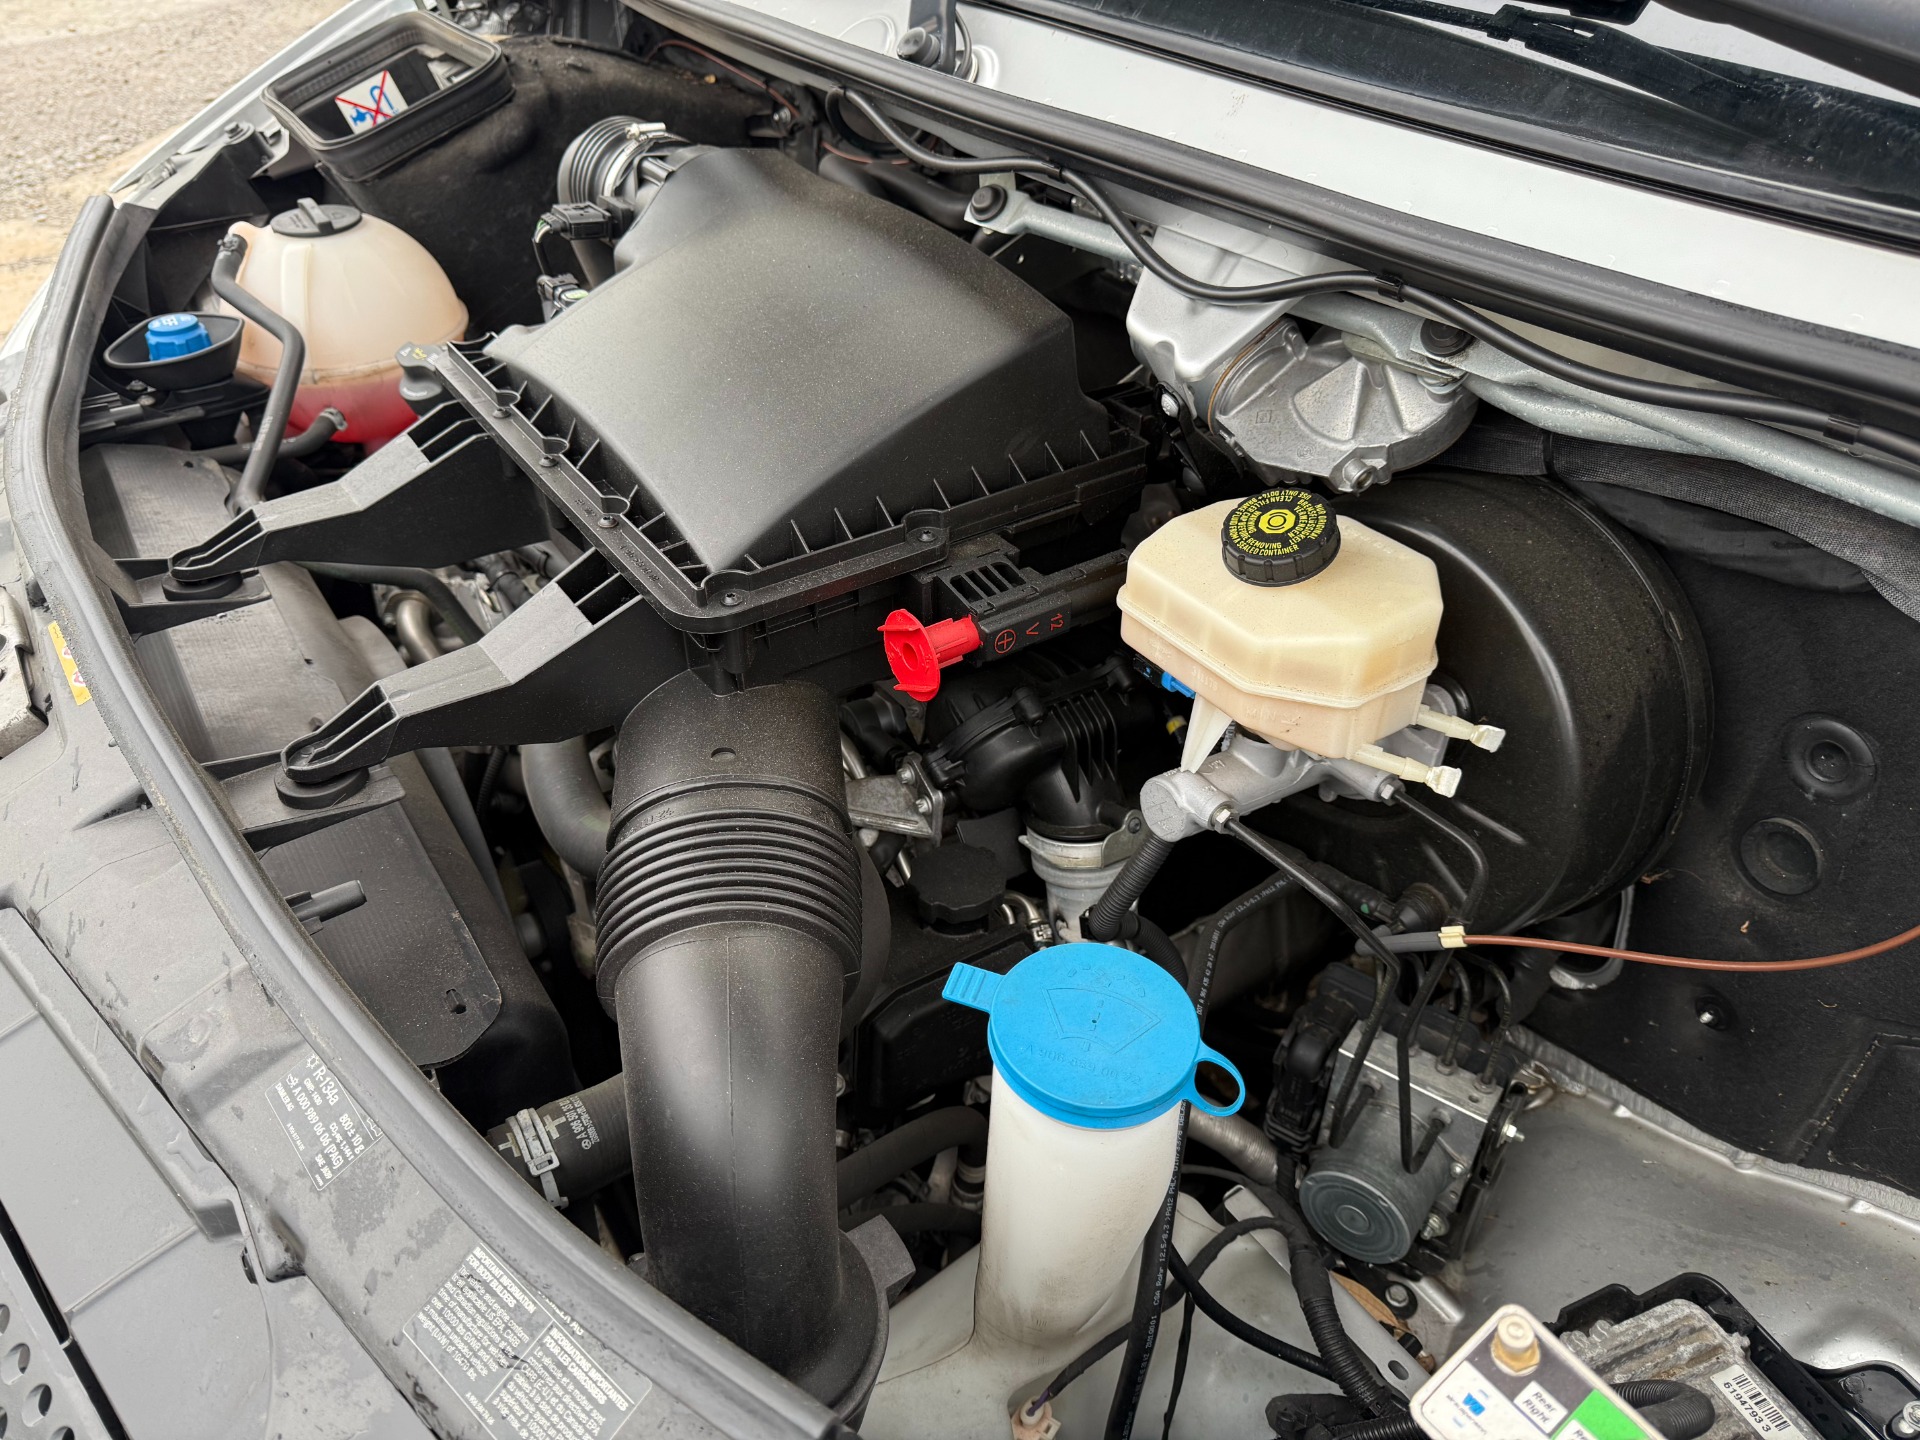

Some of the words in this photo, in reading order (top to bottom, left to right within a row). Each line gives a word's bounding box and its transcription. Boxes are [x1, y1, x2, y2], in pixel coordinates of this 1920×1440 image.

[1237, 497, 1257, 512] BRAKE
[1248, 497, 1269, 511] FILLER
[1297, 492, 1310, 500] USE
[1229, 510, 1239, 525] FLUID
[1240, 511, 1250, 520] CAP
[1247, 510, 1262, 533] WARNING
[1236, 540, 1259, 554] SEALED
[1247, 537, 1281, 548] REMOVING
[1258, 544, 1298, 555] CONTAINER
[1025, 622, 1040, 638] V
[1049, 612, 1064, 630] 12
[292, 1086, 302, 1096] A
[313, 1066, 339, 1105] R-134a
[296, 1092, 310, 1110] 000
[311, 1091, 322, 1105] 1430
[275, 1082, 290, 1104] DAIMLER
[285, 1102, 294, 1112] AG
[315, 1153, 326, 1167] SAE
[304, 1107, 319, 1124] 989
[339, 1113, 353, 1130] 800
[565, 1110, 578, 1121] 501
[570, 1119, 584, 1133] 906
[313, 1122, 325, 1136] 06
[319, 1132, 331, 1146] 06
[576, 1131, 587, 1139] A
[351, 1134, 363, 1146] 10
[354, 1144, 365, 1154] g
[324, 1143, 344, 1169] (PAG)
[1168, 1174, 1176, 1194] PHL<
[1164, 1197, 1173, 1221] >PA12
[466, 1254, 480, 1269] FOR
[476, 1265, 494, 1282] BODY
[490, 1279, 516, 1307] BUILDERS
[473, 1247, 503, 1278] IMPORTANT
[500, 1275, 536, 1313] INFORMATION
[1155, 1266, 1164, 1286] Rohr
[444, 1281, 457, 1294] and
[453, 1290, 476, 1316] Canadian
[474, 1313, 501, 1343] regulations
[504, 1345, 516, 1358] the
[451, 1272, 459, 1282] to
[456, 1279, 466, 1288] all
[462, 1286, 487, 1312] applicable
[485, 1308, 496, 1321] US
[491, 1316, 505, 1333] EPA,
[502, 1329, 520, 1347] CARB
[467, 1277, 485, 1296] vehicle
[483, 1293, 495, 1305] and
[490, 1303, 510, 1322] engine
[508, 1320, 530, 1343] conform
[431, 1296, 444, 1310] over
[442, 1307, 459, 1326] 10000
[456, 1323, 466, 1335] lbs
[463, 1332, 481, 1351] GVWR
[477, 1349, 490, 1362] and
[486, 1358, 499, 1372] has
[437, 1288, 450, 1303] time
[448, 1300, 457, 1308] of
[453, 1306, 483, 1339] manufacture
[481, 1335, 491, 1347] for
[488, 1344, 509, 1368] vehicles
[417, 1312, 435, 1332] weight
[431, 1328, 449, 1349] (UVW)
[446, 1345, 456, 1353] of
[452, 1350, 470, 1371] 10470
[428, 1308, 452, 1335] maximum
[449, 1332, 473, 1358] unloaded
[470, 1355, 488, 1377] vehicle
[543, 1335, 561, 1355] POUR
[557, 1351, 571, 1366] LES
[568, 1362, 607, 1404] CARROSSIERS
[550, 1328, 591, 1371] INFORMATIONS
[588, 1368, 628, 1411] IMPORTANTES
[527, 1356, 555, 1386] conformes
[552, 1383, 564, 1397] aux
[562, 1394, 589, 1423] directives
[585, 1419, 600, 1436] EPA
[533, 1347, 543, 1358] Le
[541, 1355, 563, 1379] véhicule
[560, 1377, 570, 1386] et
[566, 1382, 574, 1392] le
[572, 1389, 593, 1411] moteur
[590, 1409, 606, 1425] sont
[513, 1372, 532, 1393] cables
[538, 1401, 552, 1416] date
[550, 1413, 560, 1424] de
[521, 1363, 537, 1382] CARB
[549, 1397, 559, 1406] et
[563, 1410, 584, 1435] Canada
[1532, 1391, 1556, 1412] Rear
[1723, 1382, 1763, 1423] 6194793
[1761, 1424, 1771, 1432] 3
[499, 1389, 525, 1416] supérieur
[527, 1419, 546, 1440] 10000
[514, 1389, 536, 1414] véhicule
[533, 1411, 550, 1430] ayant
[547, 1427, 557, 1438] un
[1523, 1399, 1550, 1423] Right
